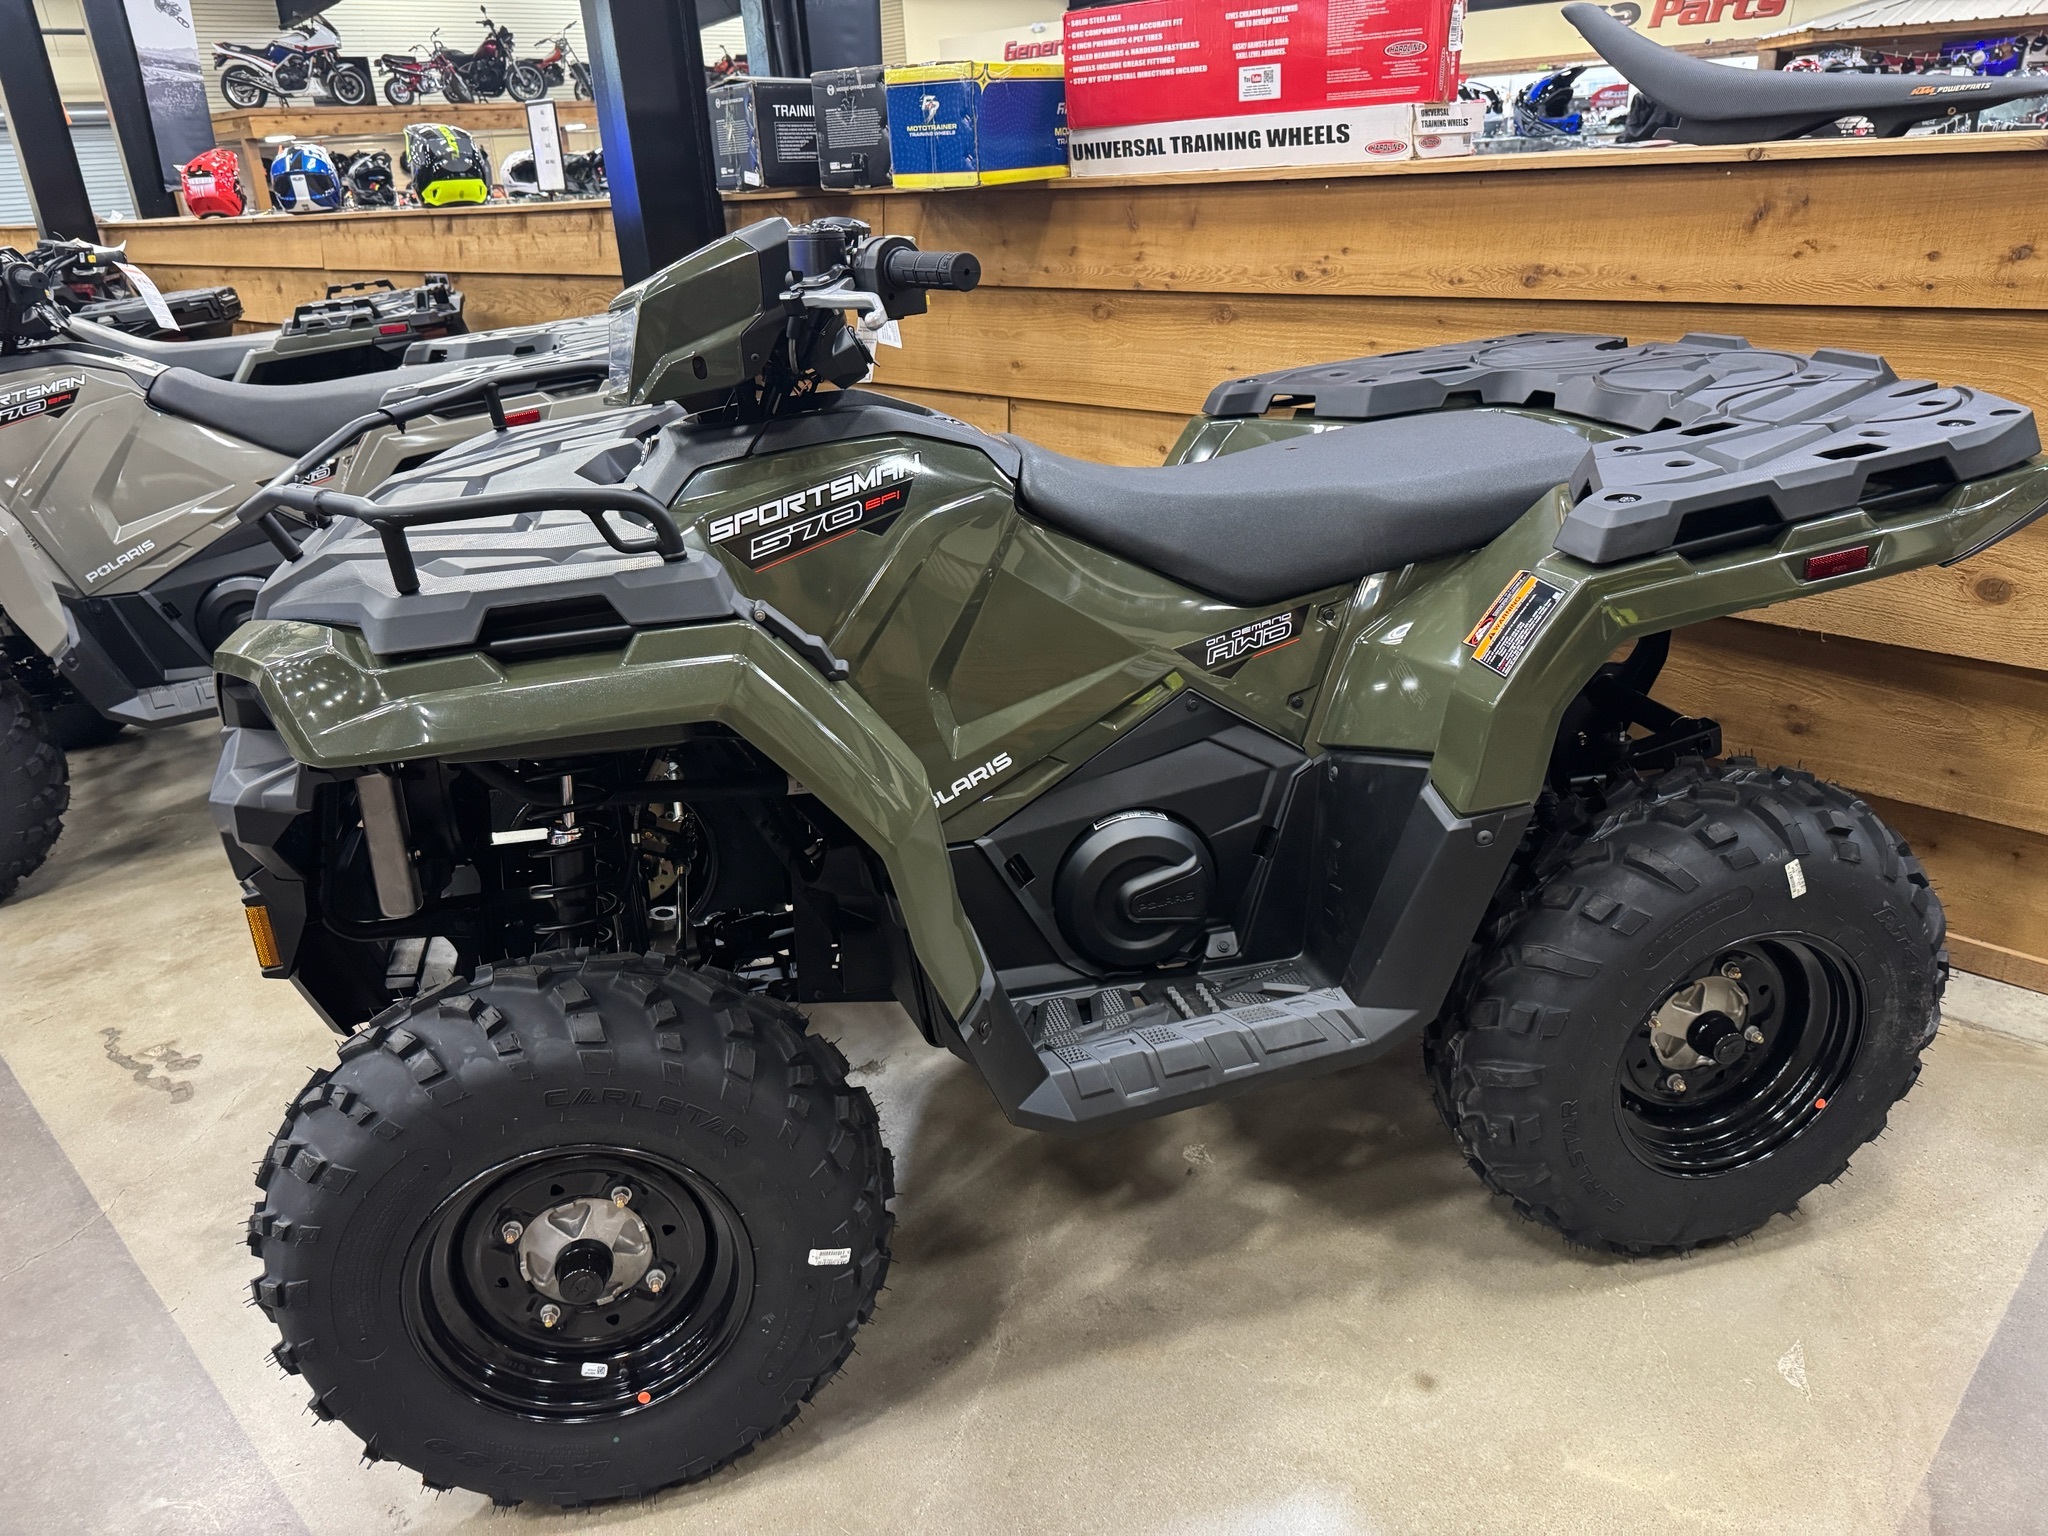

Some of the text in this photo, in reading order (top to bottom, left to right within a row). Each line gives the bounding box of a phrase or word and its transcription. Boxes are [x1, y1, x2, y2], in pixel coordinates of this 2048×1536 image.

[1071, 14, 1122, 27] SOLID STEEL AXLE
[1648, 0, 1786, 29] Parts
[1071, 31, 1084, 39] CNC
[1084, 26, 1126, 38] COMPONENTS
[1139, 20, 1172, 31] ACCURATE
[1173, 18, 1183, 26] FIT
[1072, 53, 1094, 62] SEALED
[1094, 50, 1124, 61] BEARINGS
[1130, 45, 1163, 56] HARDENED
[1164, 41, 1200, 52] FASTENERS
[1076, 41, 1092, 50] INCH
[1092, 38, 1127, 49] PNEUMATIC
[1133, 36, 1144, 44] PLY
[1144, 33, 1163, 42] TIRES
[1389, 43, 1423, 52] HARDLINE
[1073, 56, 1175, 73] WHEELS INCLUDE GREASE FITTINGS
[1073, 65, 1208, 85] STEP BY STEP INSTALL DIRECTIONS INCLUDED
[1936, 82, 1993, 94] POWERPARTS
[1421, 108, 1449, 117] UNIVERSAL
[906, 124, 957, 132] MOTOTRAINER
[1421, 118, 1469, 129] TRAINING WHEELS
[1072, 124, 1350, 161] UNIVERSAL TRAINING WHEELS
[1369, 143, 1402, 153] HARDLINE
[709, 451, 922, 545] SPORTSMAN
[750, 490, 900, 560] 570 EFI
[85, 540, 156, 583] POLARIS
[1493, 596, 1522, 631] WARNING
[1206, 621, 1292, 666] AWD
[1137, 891, 1195, 913] POLARIS
[542, 1087, 751, 1150] CARLSTAR
